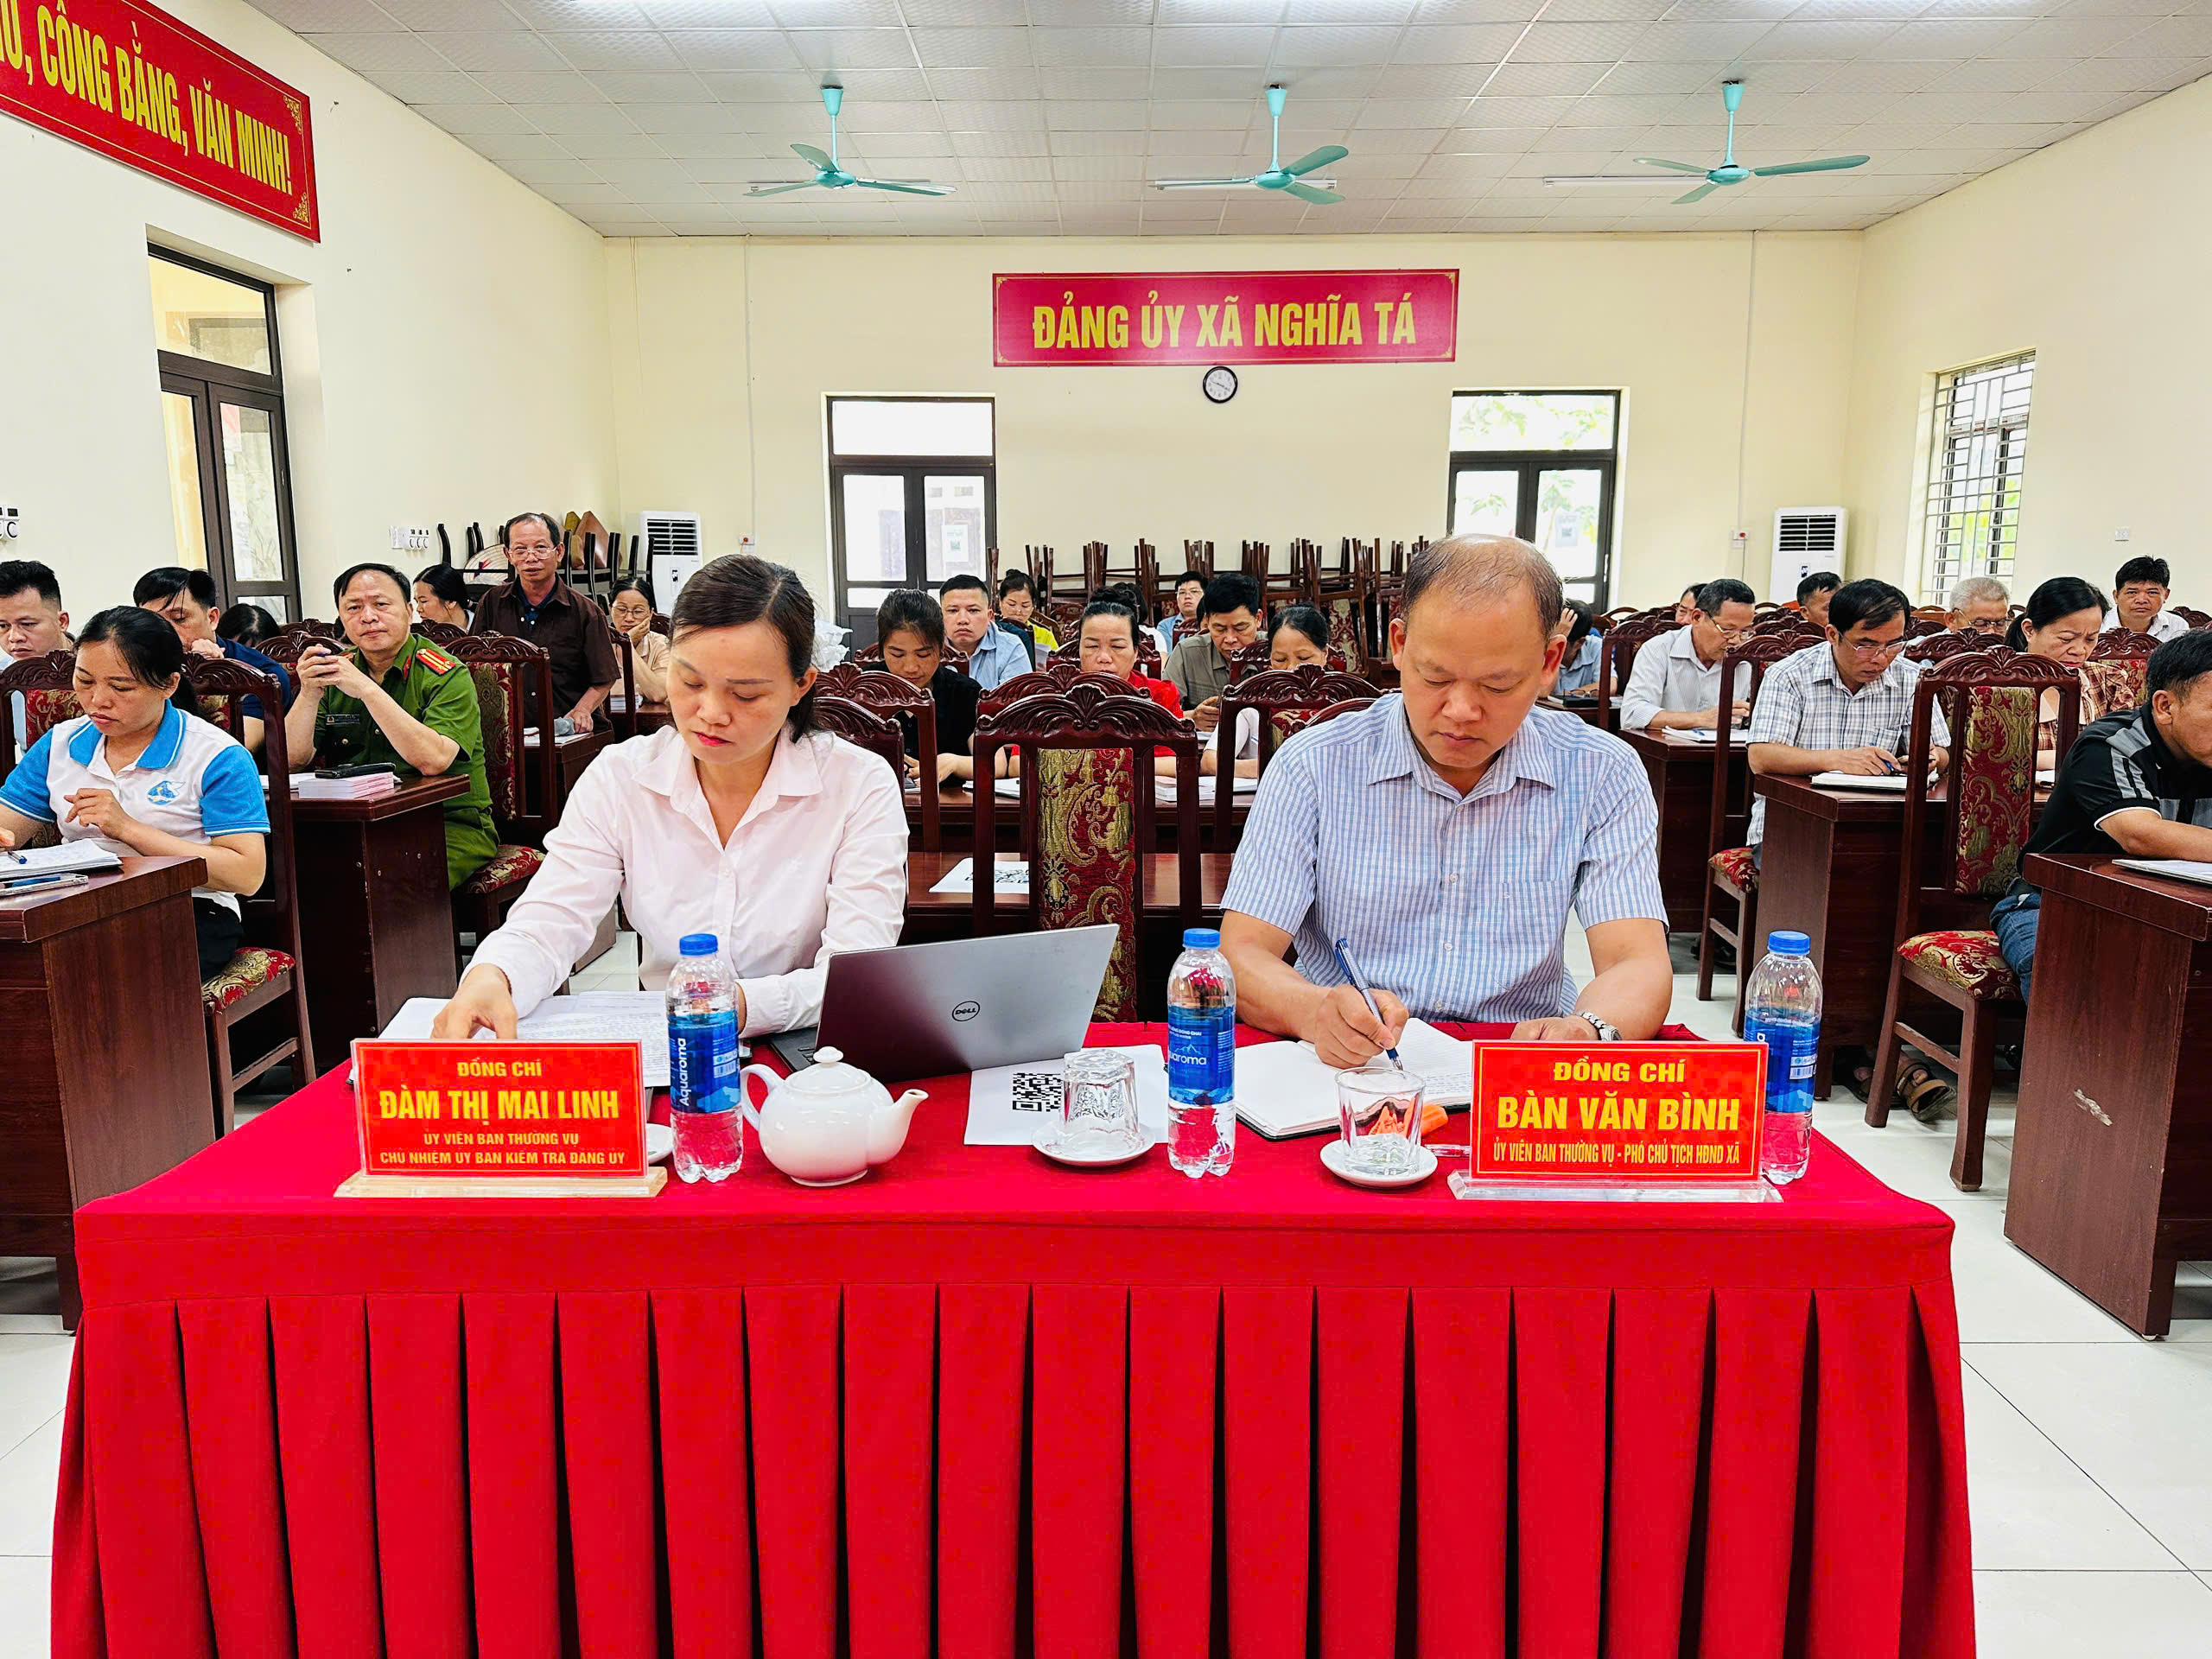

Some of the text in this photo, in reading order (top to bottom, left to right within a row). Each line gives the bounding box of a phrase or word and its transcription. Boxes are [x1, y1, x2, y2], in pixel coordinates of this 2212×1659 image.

[37, 0, 113, 113] CÔNG
[115, 21, 188, 156] BẰNG,
[188, 77, 234, 168] VĂN
[235, 109, 293, 195] MINH!
[1033, 290, 1416, 349] ĐẢNG ỦY XÃ NGHĨA TÁ
[512, 1058, 542, 1077] CHÍ
[677, 1037, 692, 1106] Aquaroma
[1554, 1056, 1686, 1083] ĐỒNG CHÍ
[379, 1084, 620, 1126] ĐÀM THỊ MAI LINH
[1497, 1090, 1740, 1130] BÀN VĂN BÌNH
[476, 1133, 505, 1146] BAN
[1493, 1136, 1506, 1161] ỦY
[1510, 1139, 1533, 1162] VIÊN
[1535, 1143, 1556, 1162] BAN
[1559, 1139, 1599, 1163] THƯỜNG
[1601, 1143, 1615, 1167] VỤ
[1624, 1141, 1645, 1164] PHÓ
[1648, 1138, 1668, 1164] CHỦ
[1670, 1144, 1694, 1168] TỊCH
[1696, 1144, 1724, 1164] HĐND
[1726, 1141, 1740, 1164] XÃ
[476, 1152, 502, 1165] BAN
[542, 1152, 567, 1165] TRA
